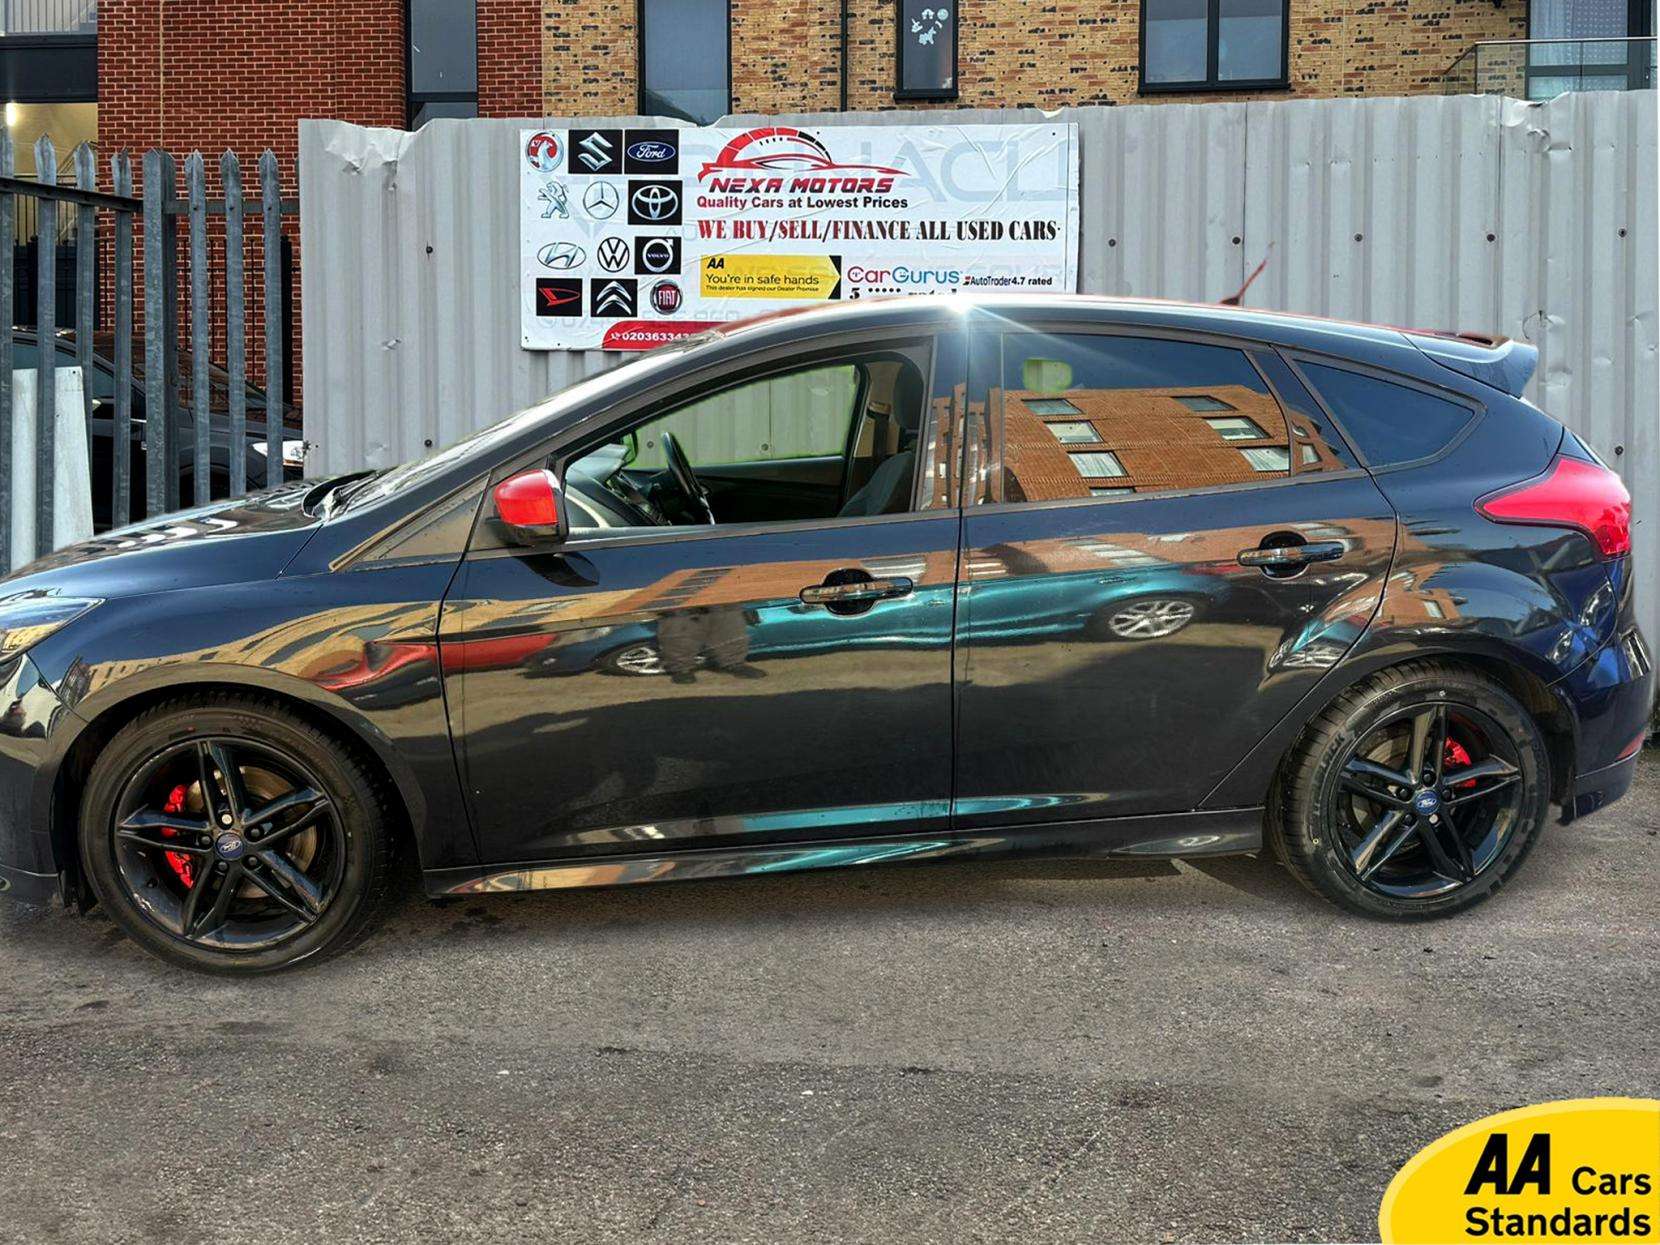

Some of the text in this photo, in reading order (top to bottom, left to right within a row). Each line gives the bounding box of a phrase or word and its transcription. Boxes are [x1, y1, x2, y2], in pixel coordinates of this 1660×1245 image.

[636, 144, 666, 159] Ford
[709, 178, 895, 194] NEXA MOTORS
[697, 196, 908, 210] Quality Cars at Lowest Prices
[697, 220, 727, 240] WE
[916, 220, 951, 240] ALL
[956, 220, 1003, 240] USED
[1008, 220, 1057, 240] CARS
[707, 258, 725, 269] AA
[706, 274, 820, 285] You're in safe hands
[847, 266, 960, 284] CarGurus
[1027, 276, 1053, 286] rated
[659, 291, 676, 305] FIAT
